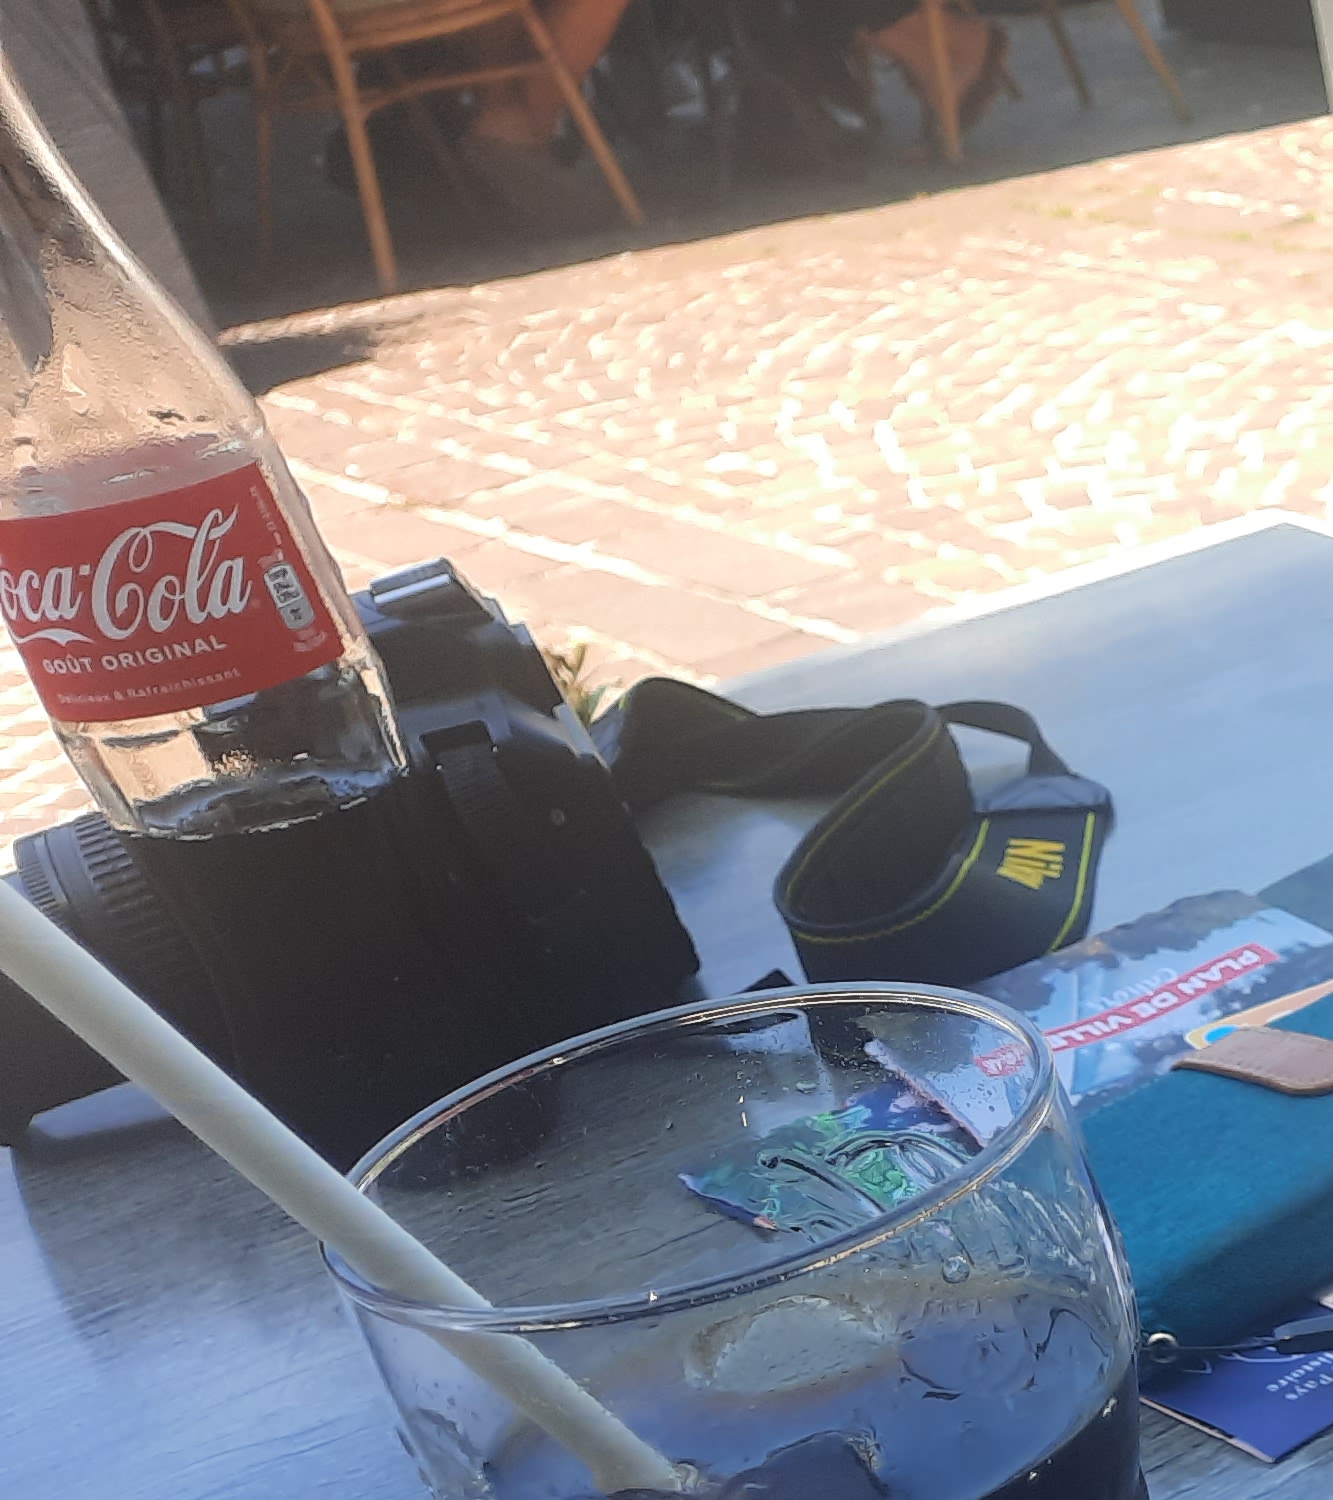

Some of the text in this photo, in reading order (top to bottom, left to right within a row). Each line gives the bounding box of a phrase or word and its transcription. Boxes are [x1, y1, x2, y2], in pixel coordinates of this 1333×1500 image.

[0, 504, 253, 642] oca-Cola
[41, 634, 228, 676] GOÛT ORIGINAL
[1176, 949, 1262, 995] PLAN
[1131, 990, 1180, 1019] DE
